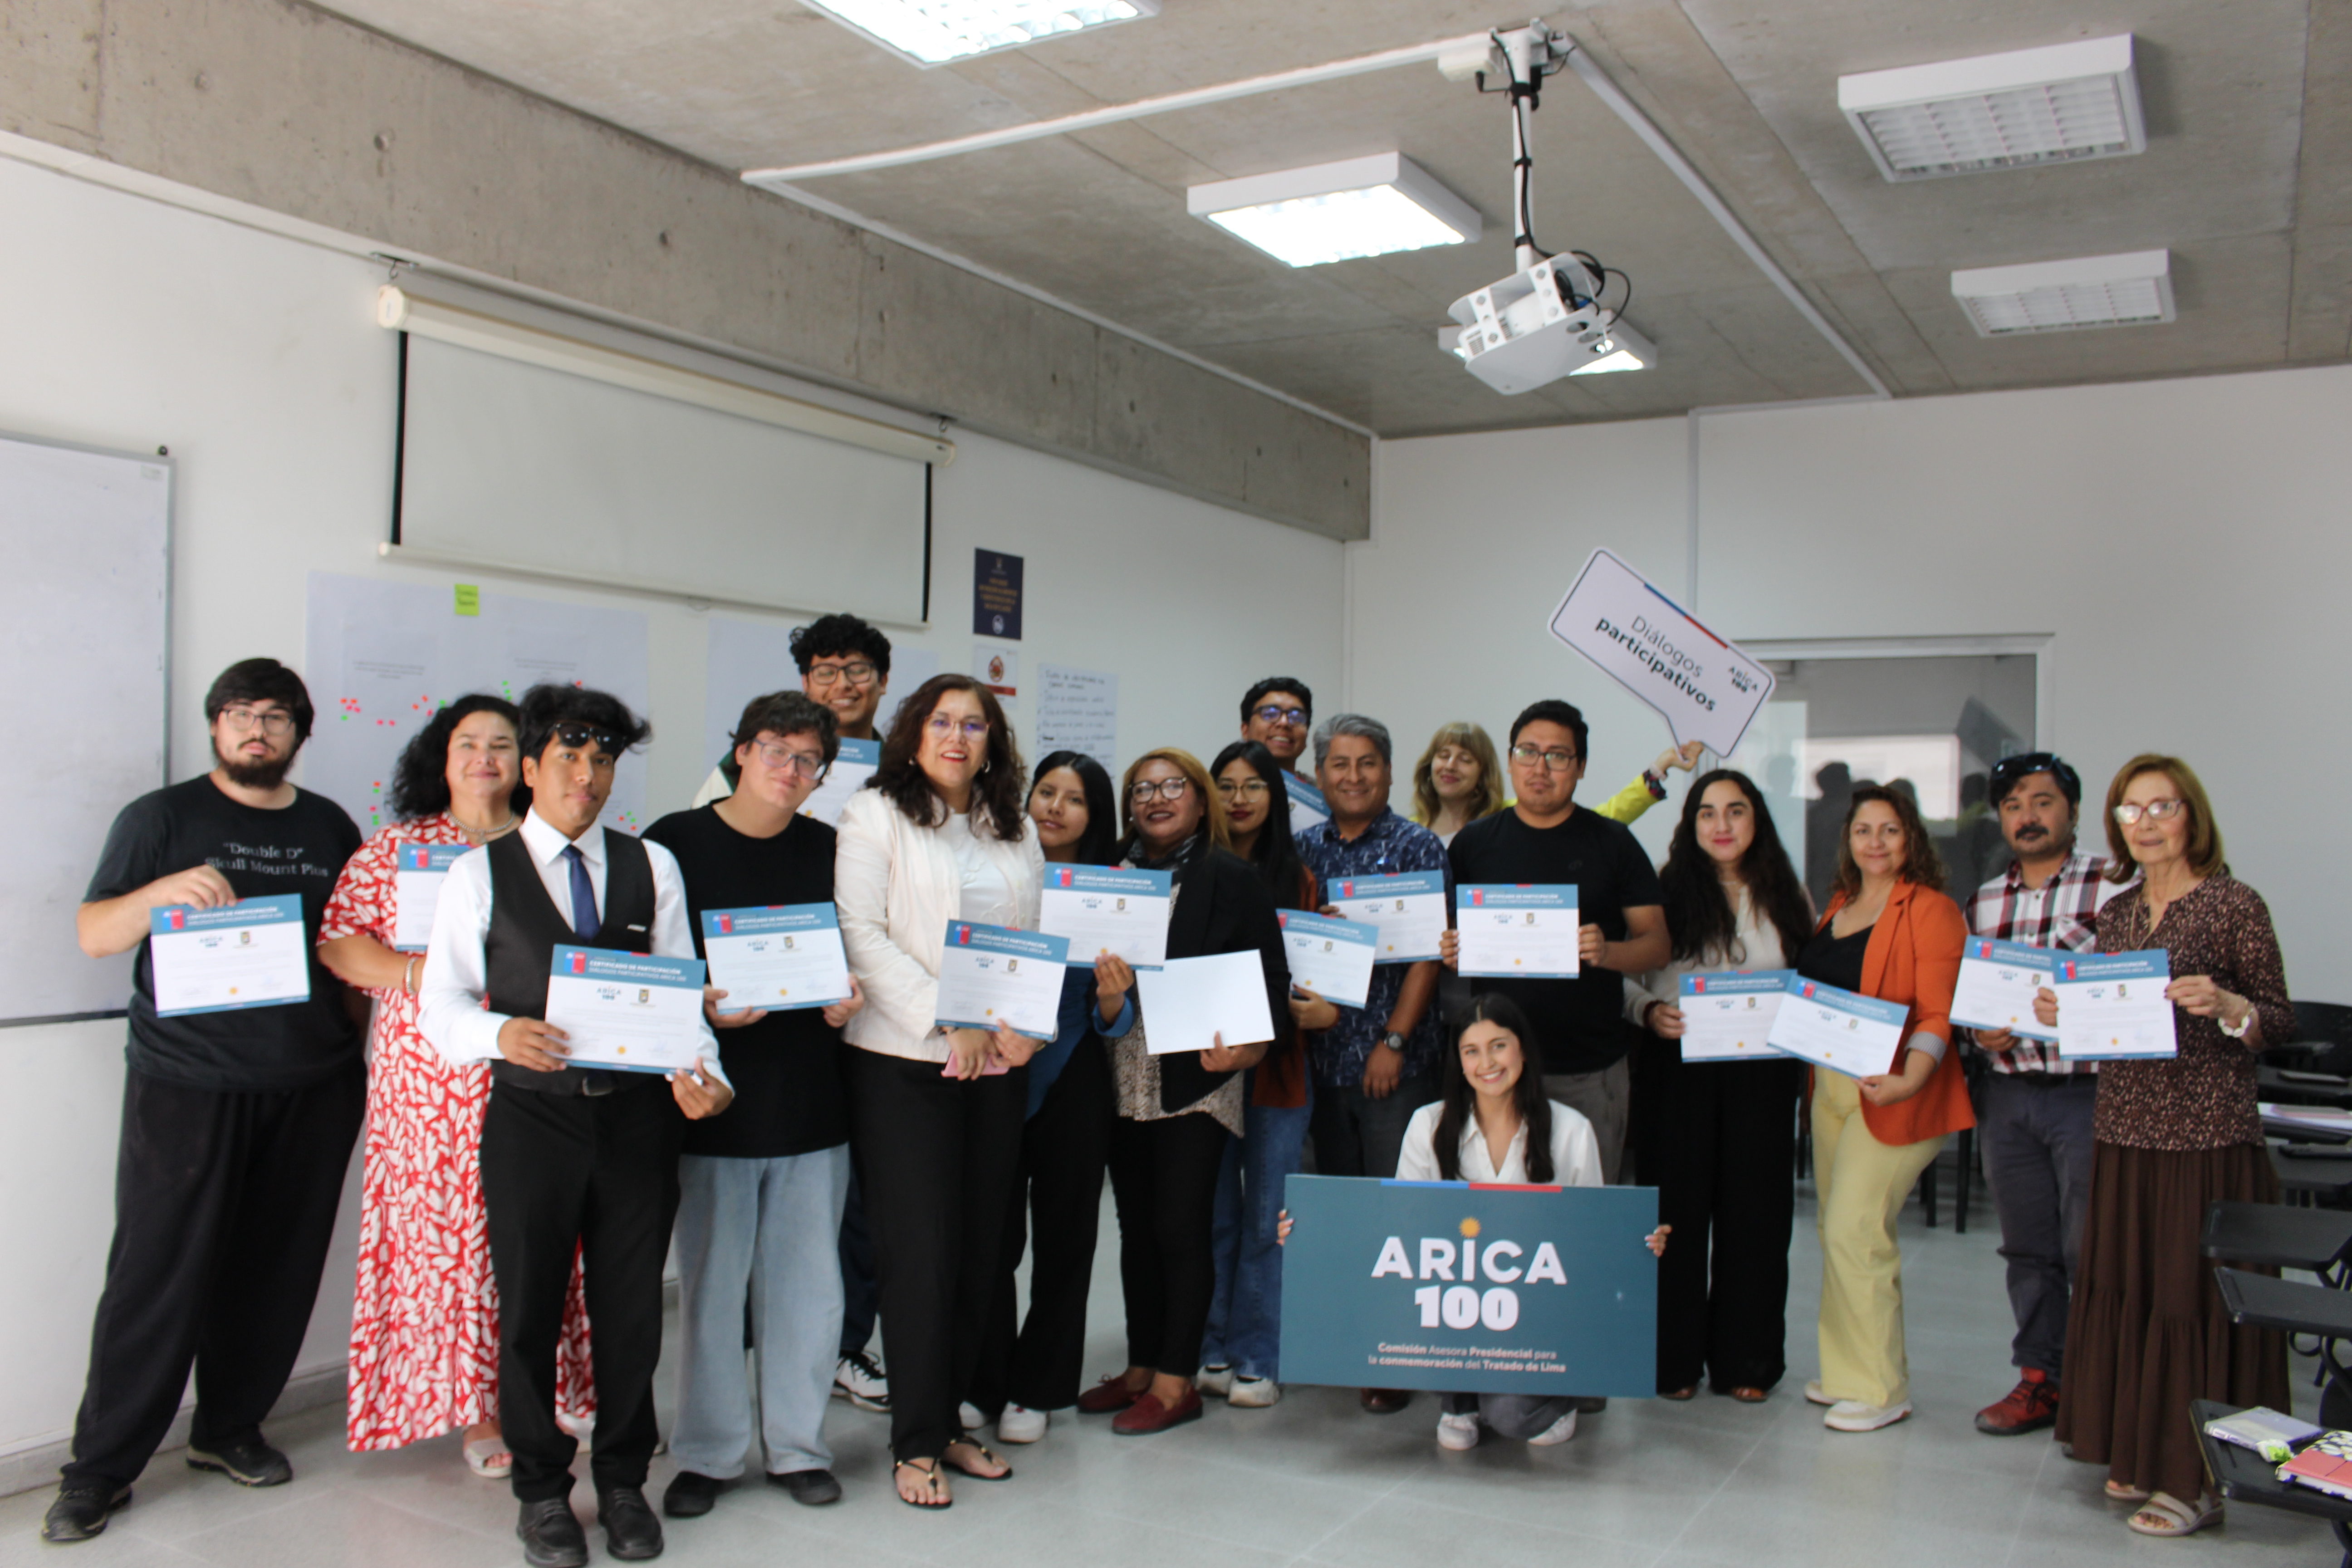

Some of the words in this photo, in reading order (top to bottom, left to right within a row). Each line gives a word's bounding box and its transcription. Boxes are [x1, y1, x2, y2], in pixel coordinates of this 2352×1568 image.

[1632, 616, 1703, 678] Diálogos
[1595, 618, 1716, 711] participativos
[1728, 666, 1759, 691] ARICA
[1731, 678, 1749, 693] 100
[205, 857, 246, 871] Skull
[250, 860, 297, 876] Mount
[301, 863, 329, 877] Plus
[589, 959, 627, 970] CERTIFICADO
[636, 964, 681, 975] PARTICIPACIÓN
[1371, 1235, 1568, 1285] ARICA
[1414, 1284, 1519, 1332] 100
[1377, 1342, 1428, 1355] Comisión
[1429, 1344, 1468, 1357] Asesora
[1470, 1346, 1533, 1359] Presidencial
[1534, 1351, 1557, 1361] para
[1367, 1354, 1377, 1365] la
[1378, 1356, 1464, 1369] conmemoración
[1465, 1359, 1481, 1370] del
[1482, 1359, 1524, 1372] Tratado
[1525, 1361, 1539, 1372] de
[1540, 1362, 1567, 1373] Lima
